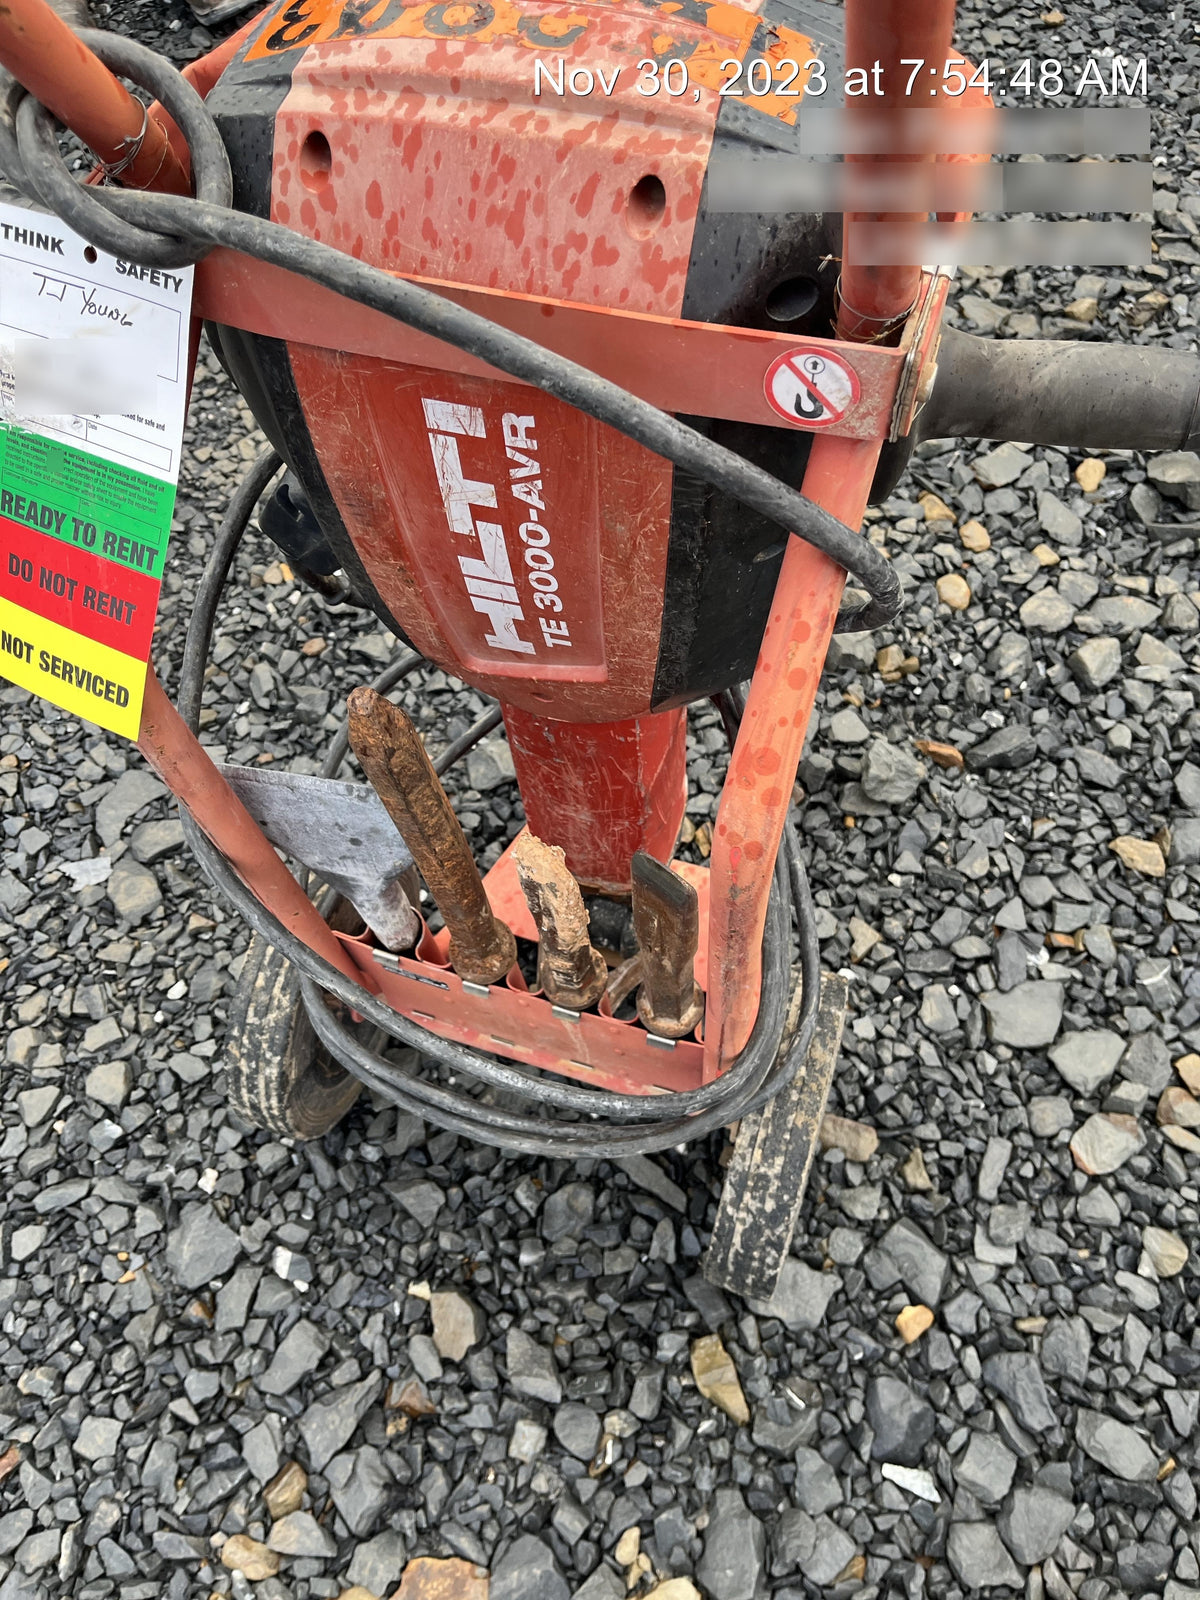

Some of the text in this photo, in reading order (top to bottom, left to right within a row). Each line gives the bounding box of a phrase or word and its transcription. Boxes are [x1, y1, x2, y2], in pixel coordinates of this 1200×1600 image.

[1, 222, 183, 293] THINK SAFETY
[144, 418, 155, 428] safe
[155, 422, 166, 432] and
[1, 489, 159, 572] READY TO RENT
[421, 398, 536, 655] HILTI
[501, 412, 573, 648] TE 3000-AVR
[8, 552, 137, 625] DO NOT RENT
[1, 629, 130, 708] NOT SERVICED
